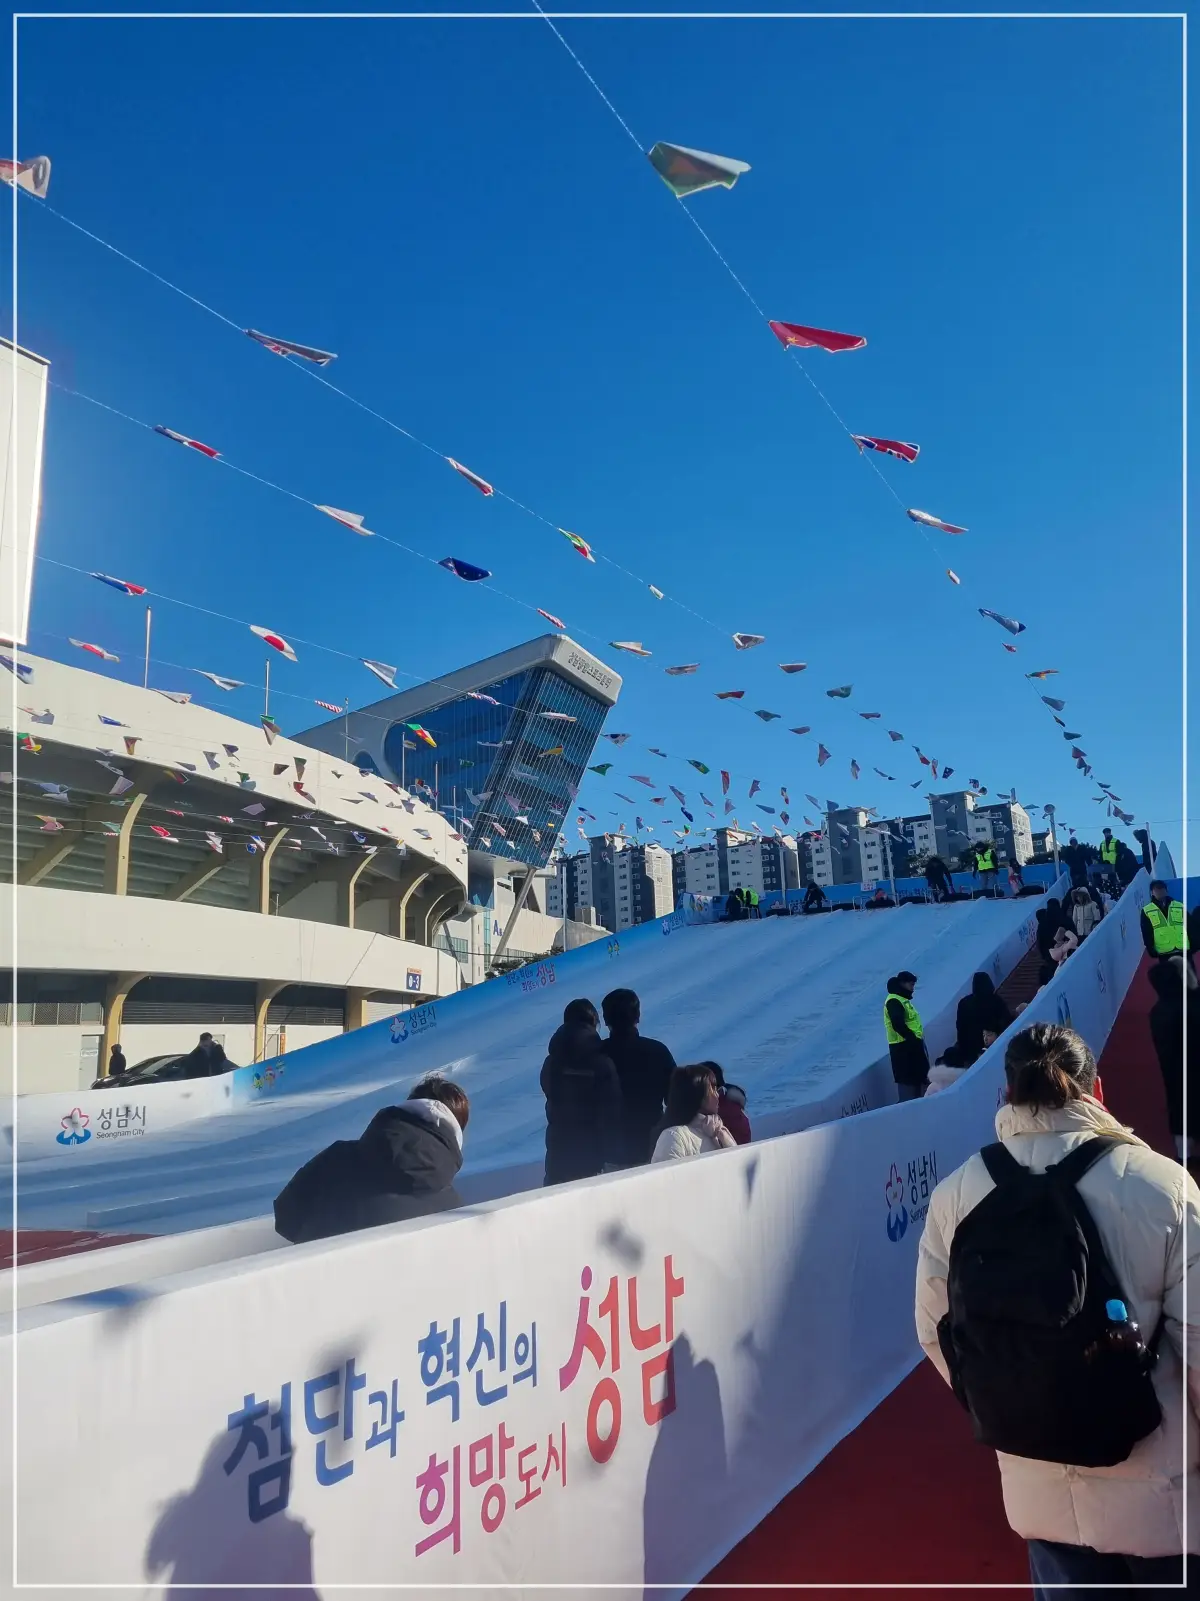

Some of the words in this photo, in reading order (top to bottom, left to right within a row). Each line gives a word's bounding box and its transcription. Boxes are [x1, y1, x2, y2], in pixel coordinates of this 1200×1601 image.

[536, 962, 555, 987] 성남
[409, 1005, 436, 1029] 성남시
[97, 1105, 147, 1131] 성남시
[96, 1130, 132, 1140] Seongnam
[132, 1128, 145, 1136] City
[907, 1150, 938, 1206] 성남시
[223, 1358, 405, 1525] 첨단과
[417, 1300, 538, 1424] 혁신의
[559, 1254, 685, 1464] 성남
[415, 1421, 567, 1557] 희망도시
